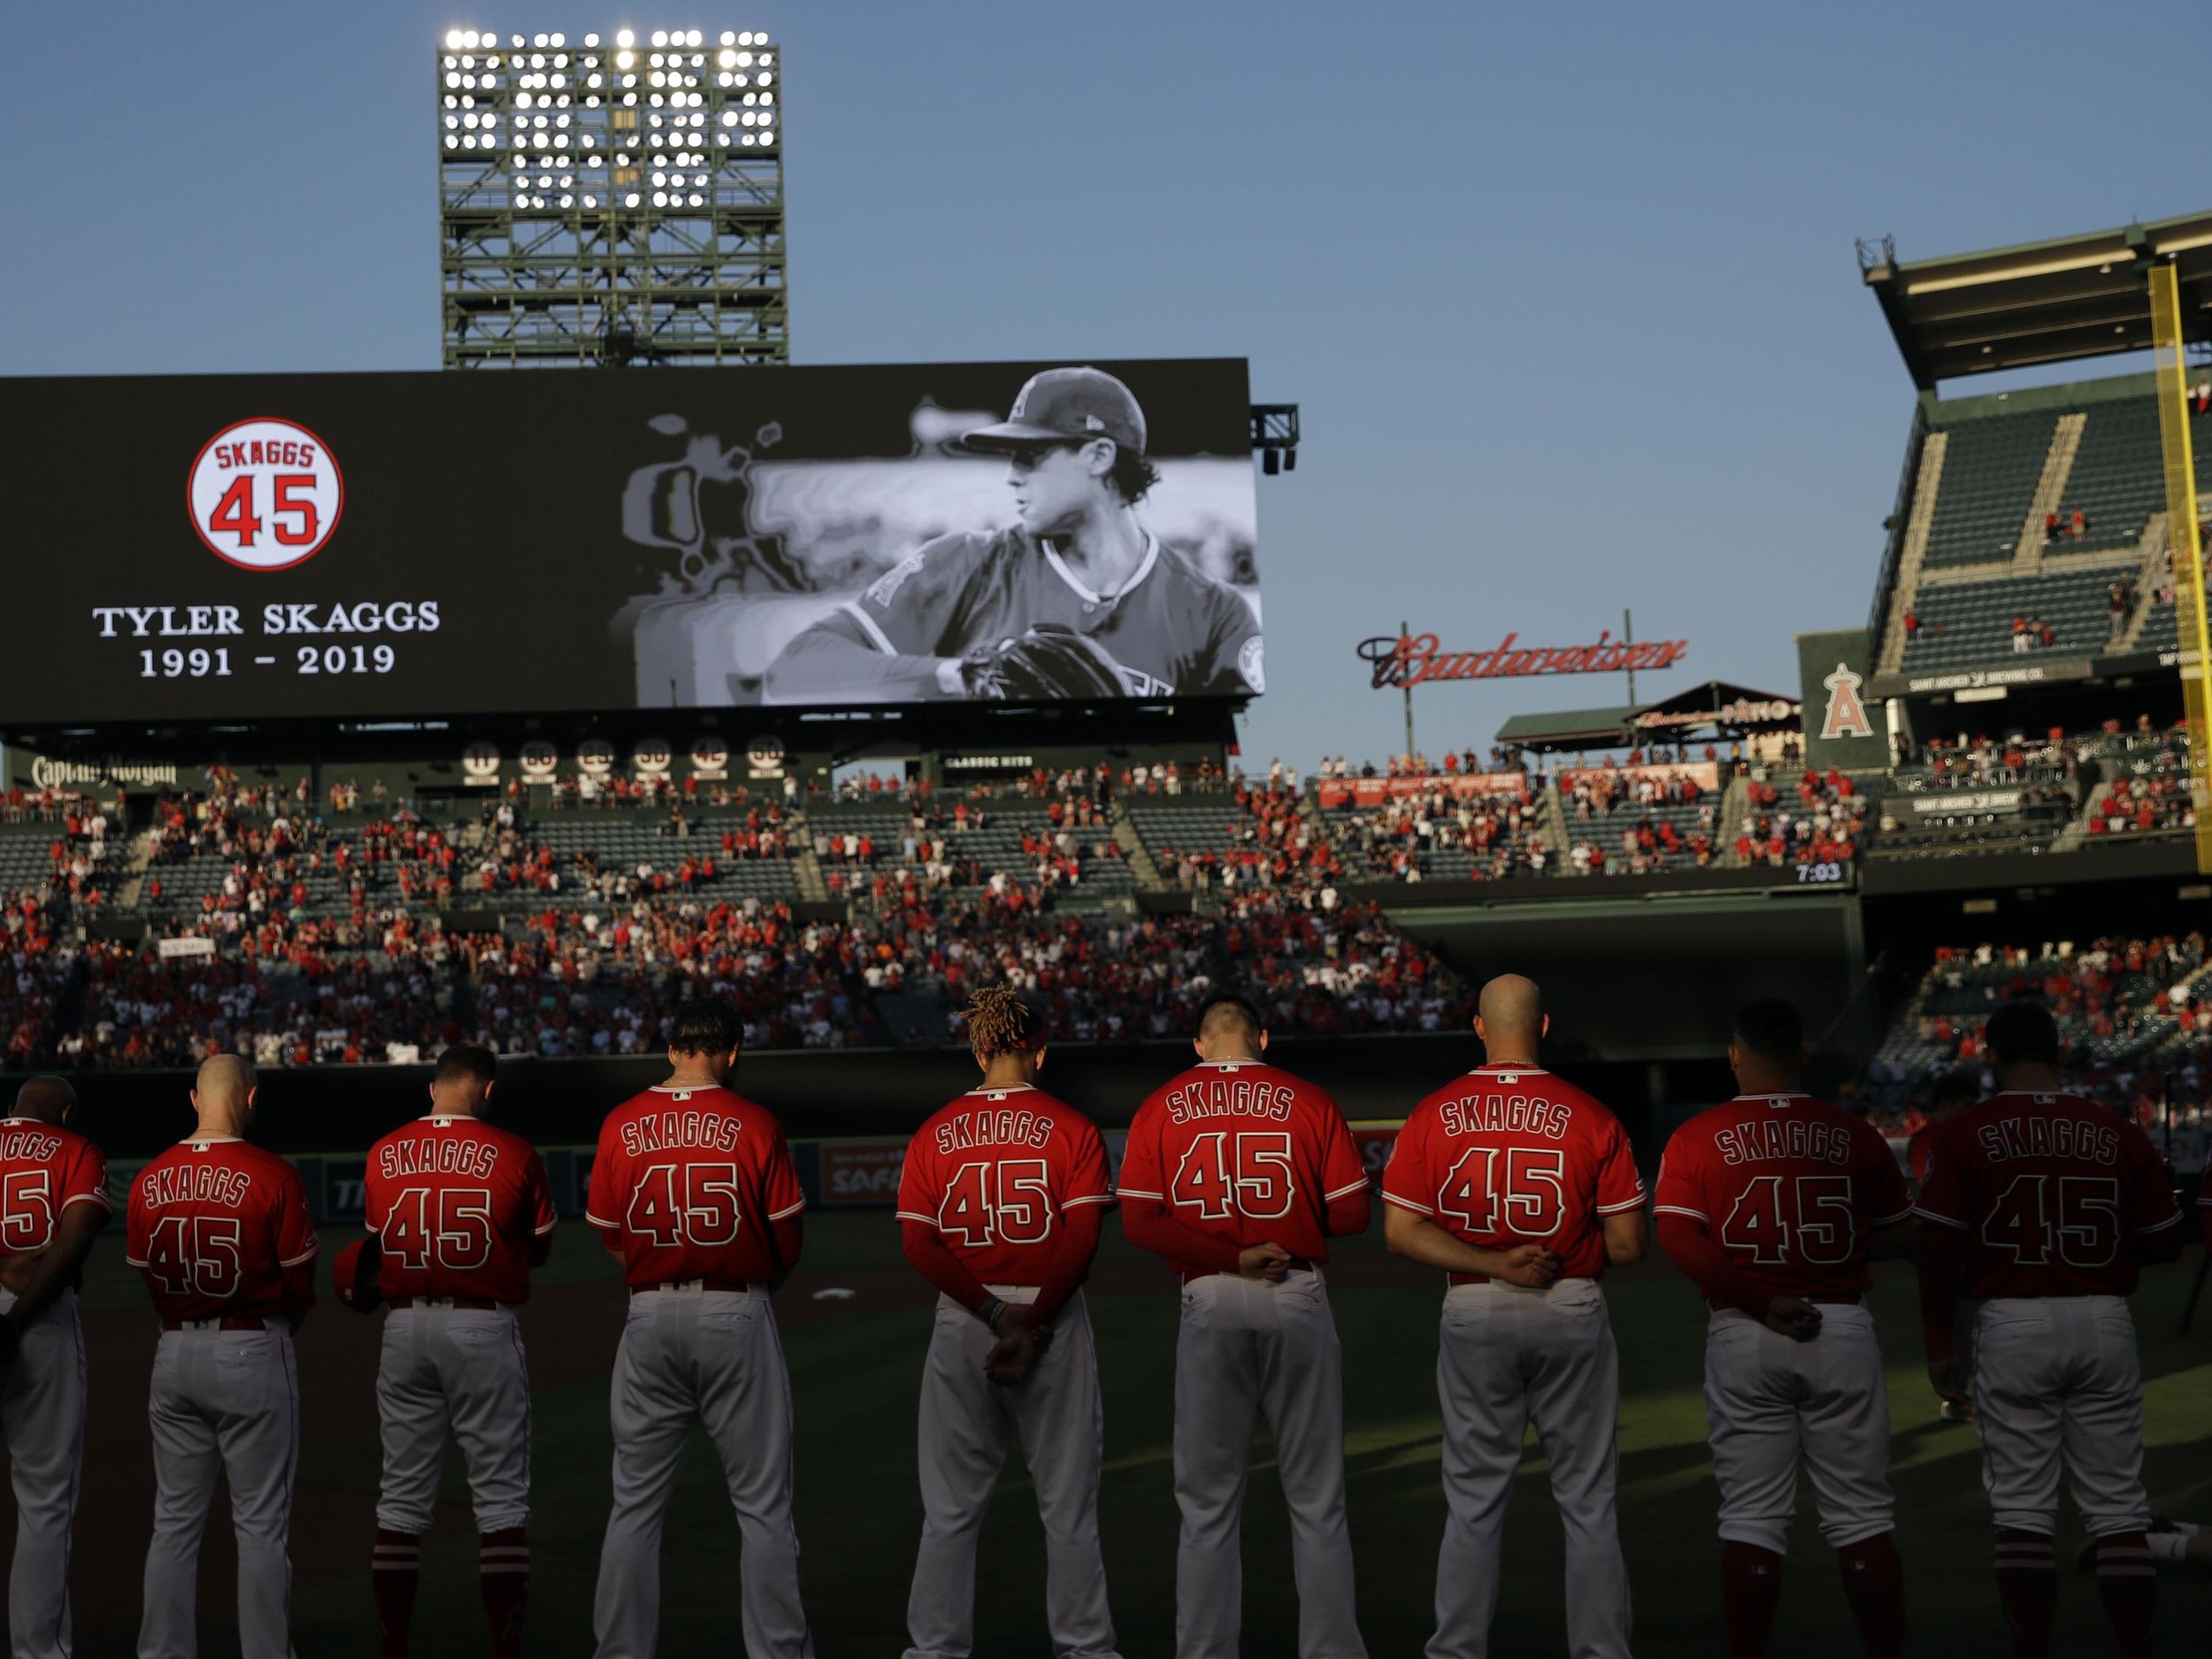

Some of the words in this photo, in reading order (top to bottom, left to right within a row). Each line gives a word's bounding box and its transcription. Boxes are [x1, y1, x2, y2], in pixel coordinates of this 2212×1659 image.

[215, 441, 316, 469] SKAGGS
[209, 472, 321, 548] 45
[92, 604, 244, 638] TYLER
[263, 600, 442, 634] SKAGGS
[139, 648, 233, 678] 1991
[296, 644, 396, 674] 2019
[1356, 630, 1689, 689] Budweiser
[1165, 1080, 1295, 1125] SKAGGS
[1440, 1094, 1572, 1141] SKAGGS
[0, 1131, 63, 1162] GGS
[621, 1111, 742, 1157] SKAGGS
[935, 1110, 1055, 1155] SKAGGS
[1714, 1119, 1853, 1166] SKAGGS
[1976, 1117, 2121, 1166] SKAGGS
[380, 1137, 498, 1180] SKAGGS
[1171, 1131, 1296, 1219] 45
[142, 1164, 251, 1210] SKAGGS
[627, 1163, 743, 1248] 45
[938, 1159, 1056, 1248] 45
[1438, 1147, 1567, 1237] 45
[380, 1187, 493, 1270] 45
[1721, 1174, 1856, 1265] 45
[1981, 1174, 2123, 1269] 45
[147, 1217, 243, 1298] 45
